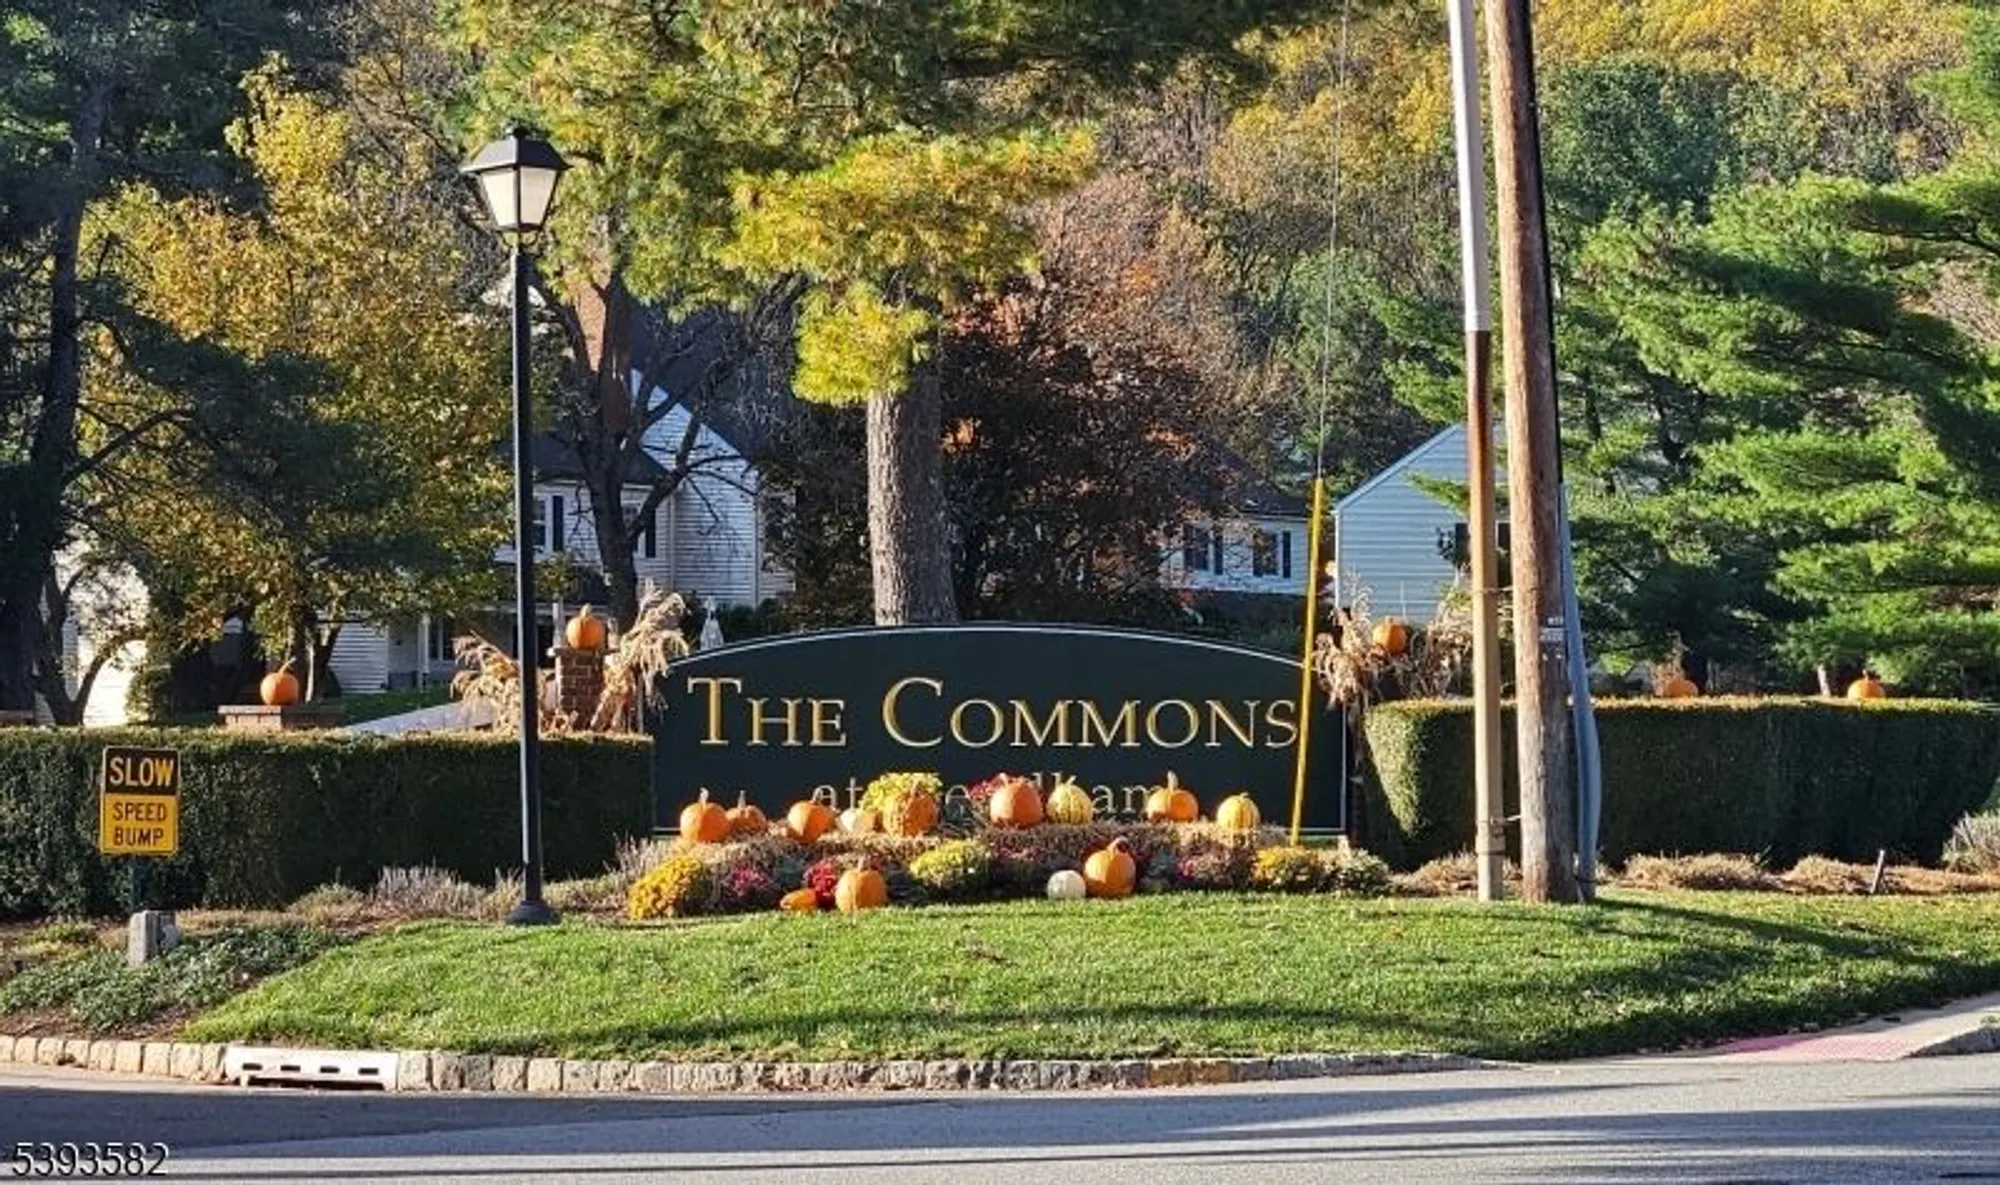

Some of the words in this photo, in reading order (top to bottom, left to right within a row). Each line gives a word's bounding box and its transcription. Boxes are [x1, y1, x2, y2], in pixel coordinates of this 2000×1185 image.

[686, 676, 848, 748] THE
[882, 676, 1299, 749] COMMONS
[109, 757, 175, 787] SLOW
[112, 802, 168, 822] SPEED
[113, 827, 164, 847] BUMP
